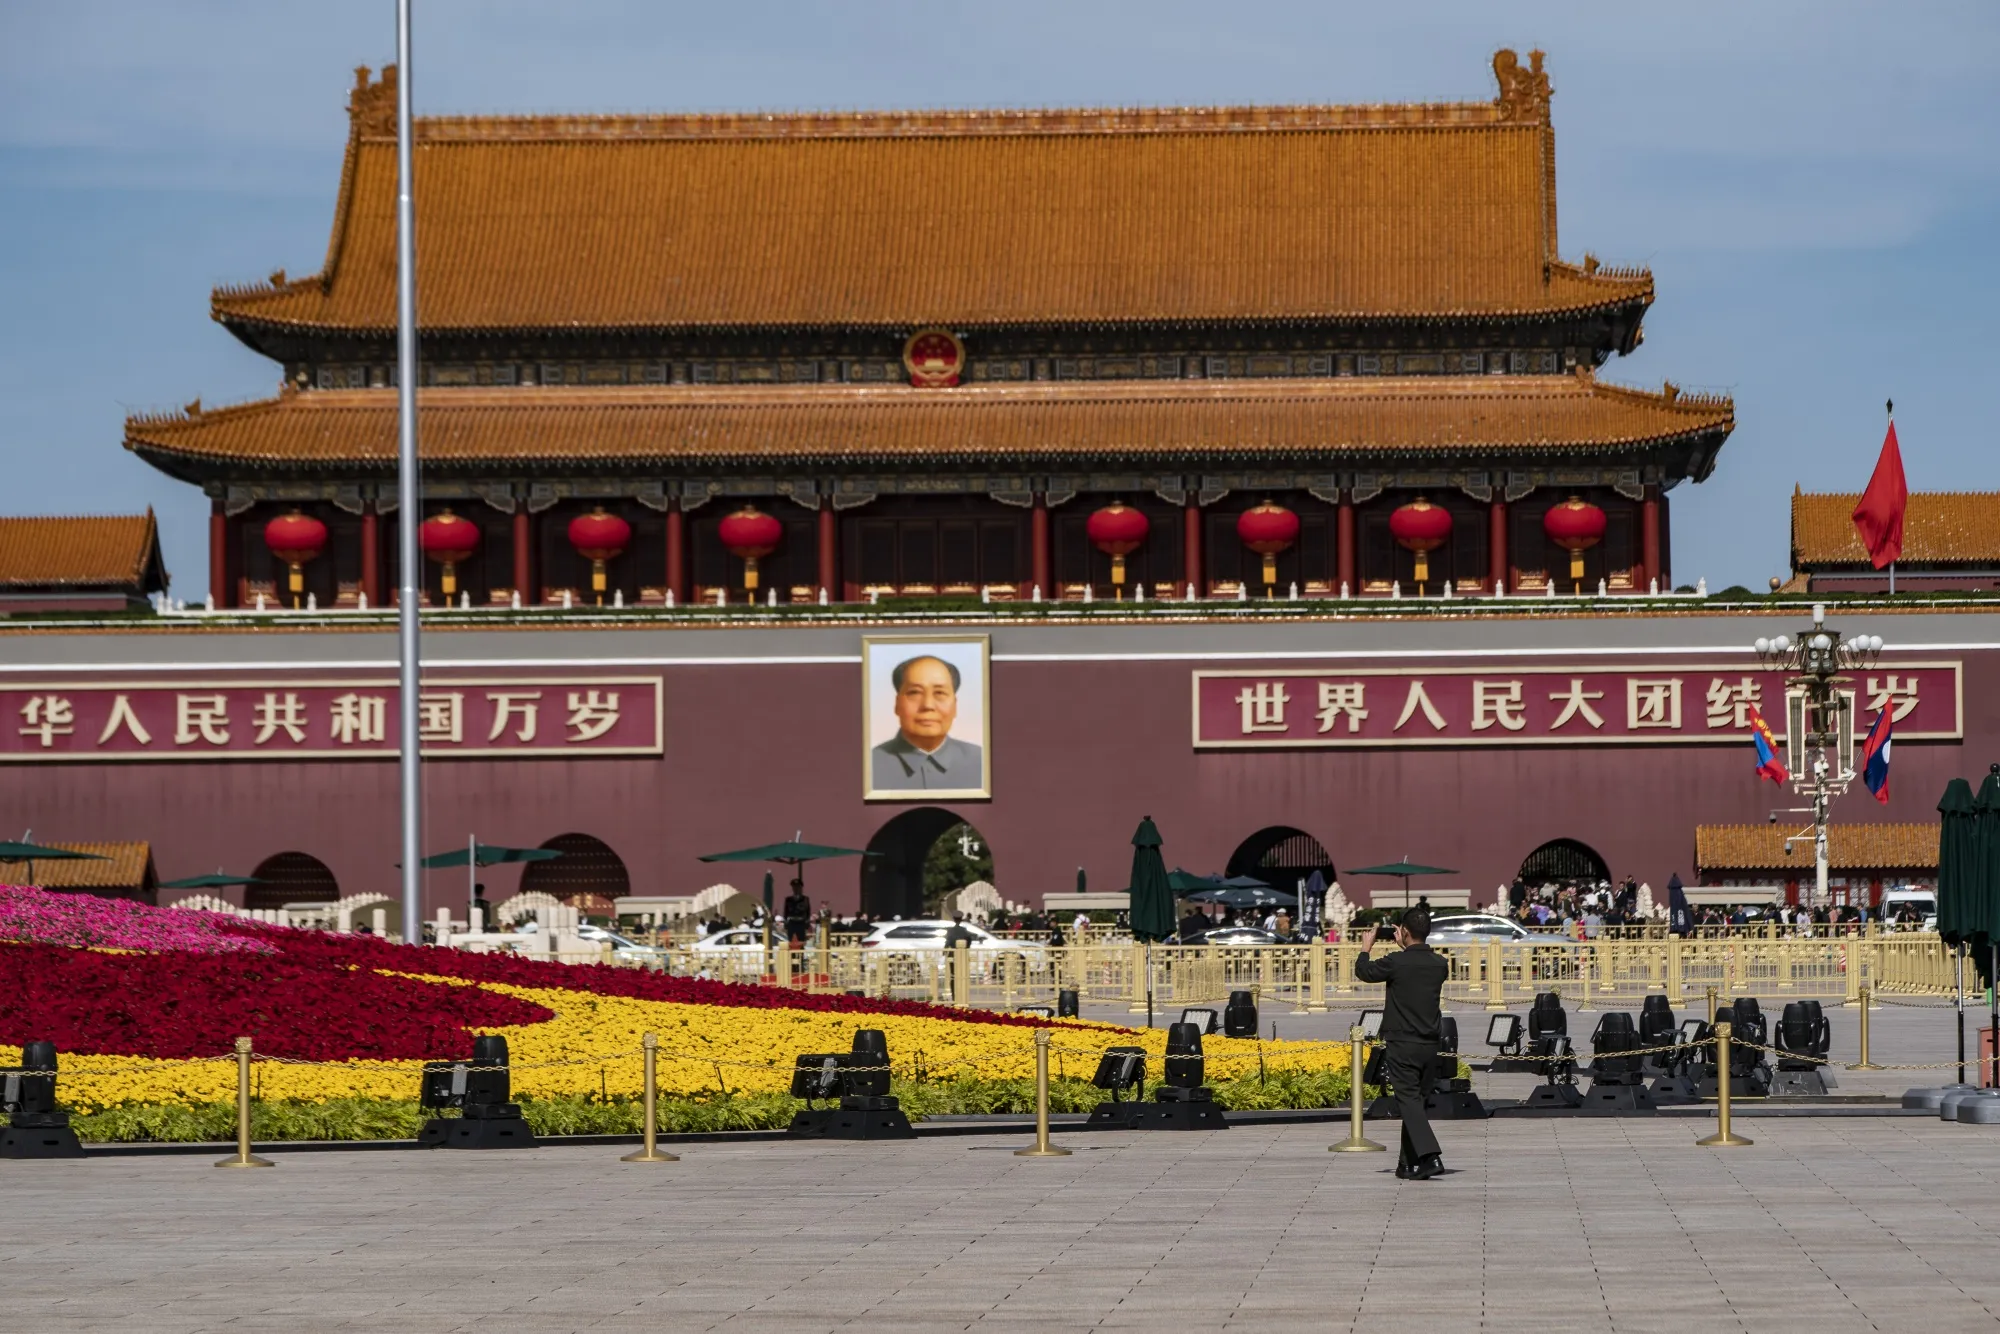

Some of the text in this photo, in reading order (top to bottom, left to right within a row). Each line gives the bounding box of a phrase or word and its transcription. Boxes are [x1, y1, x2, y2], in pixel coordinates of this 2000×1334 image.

[18, 691, 621, 747] 华人民共和国万岁
[1235, 675, 1919, 734] 世界人民大团结岁
